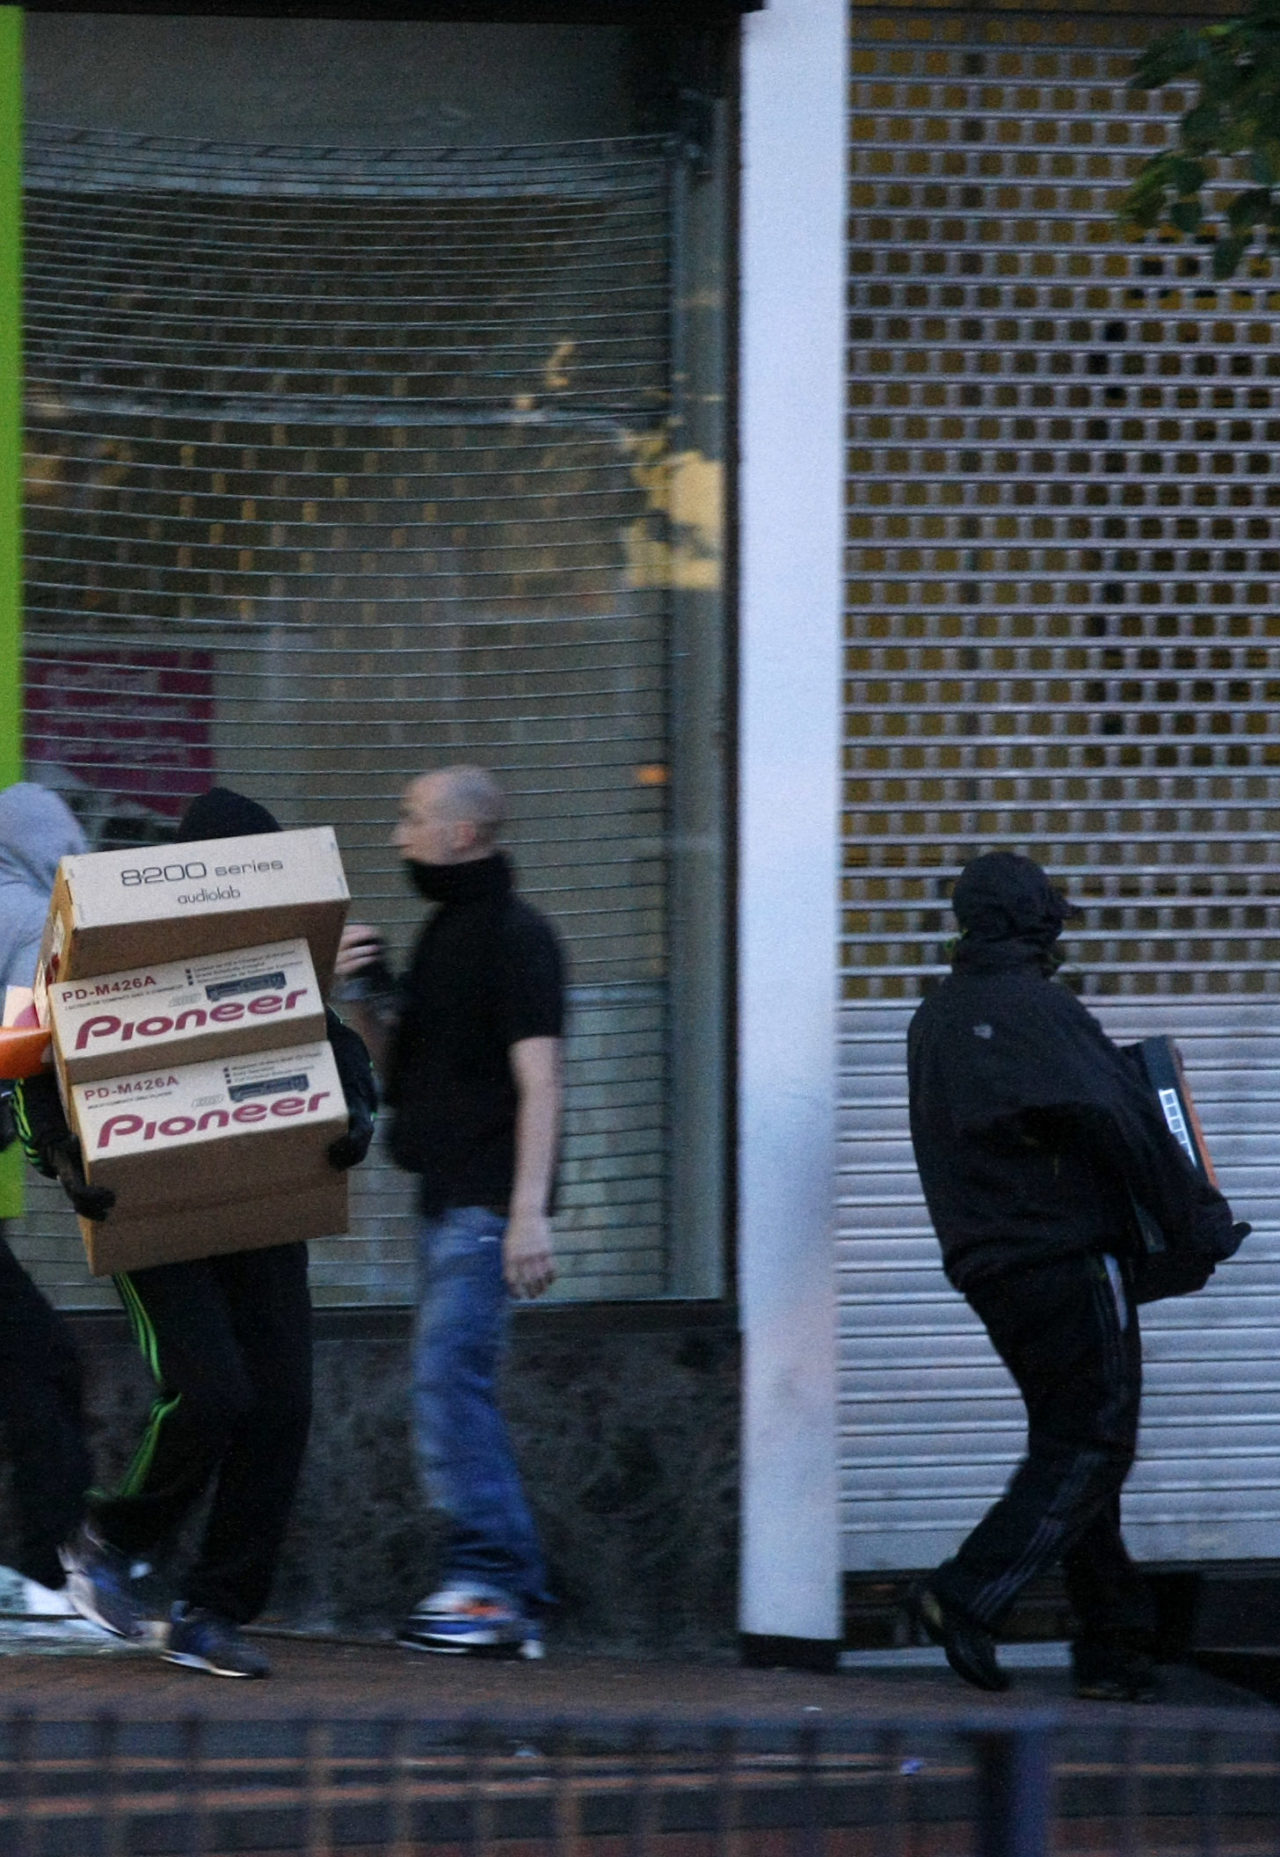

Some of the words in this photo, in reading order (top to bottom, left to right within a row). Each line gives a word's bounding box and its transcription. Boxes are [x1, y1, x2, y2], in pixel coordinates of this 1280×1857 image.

[120, 861, 207, 887] 8200
[214, 859, 284, 877] series
[177, 885, 241, 905] audiolab
[62, 975, 157, 1003] PD-M426A
[75, 988, 308, 1050] Pioneer
[83, 1075, 179, 1101] PD-M426A
[97, 1091, 331, 1149] Pioneer
